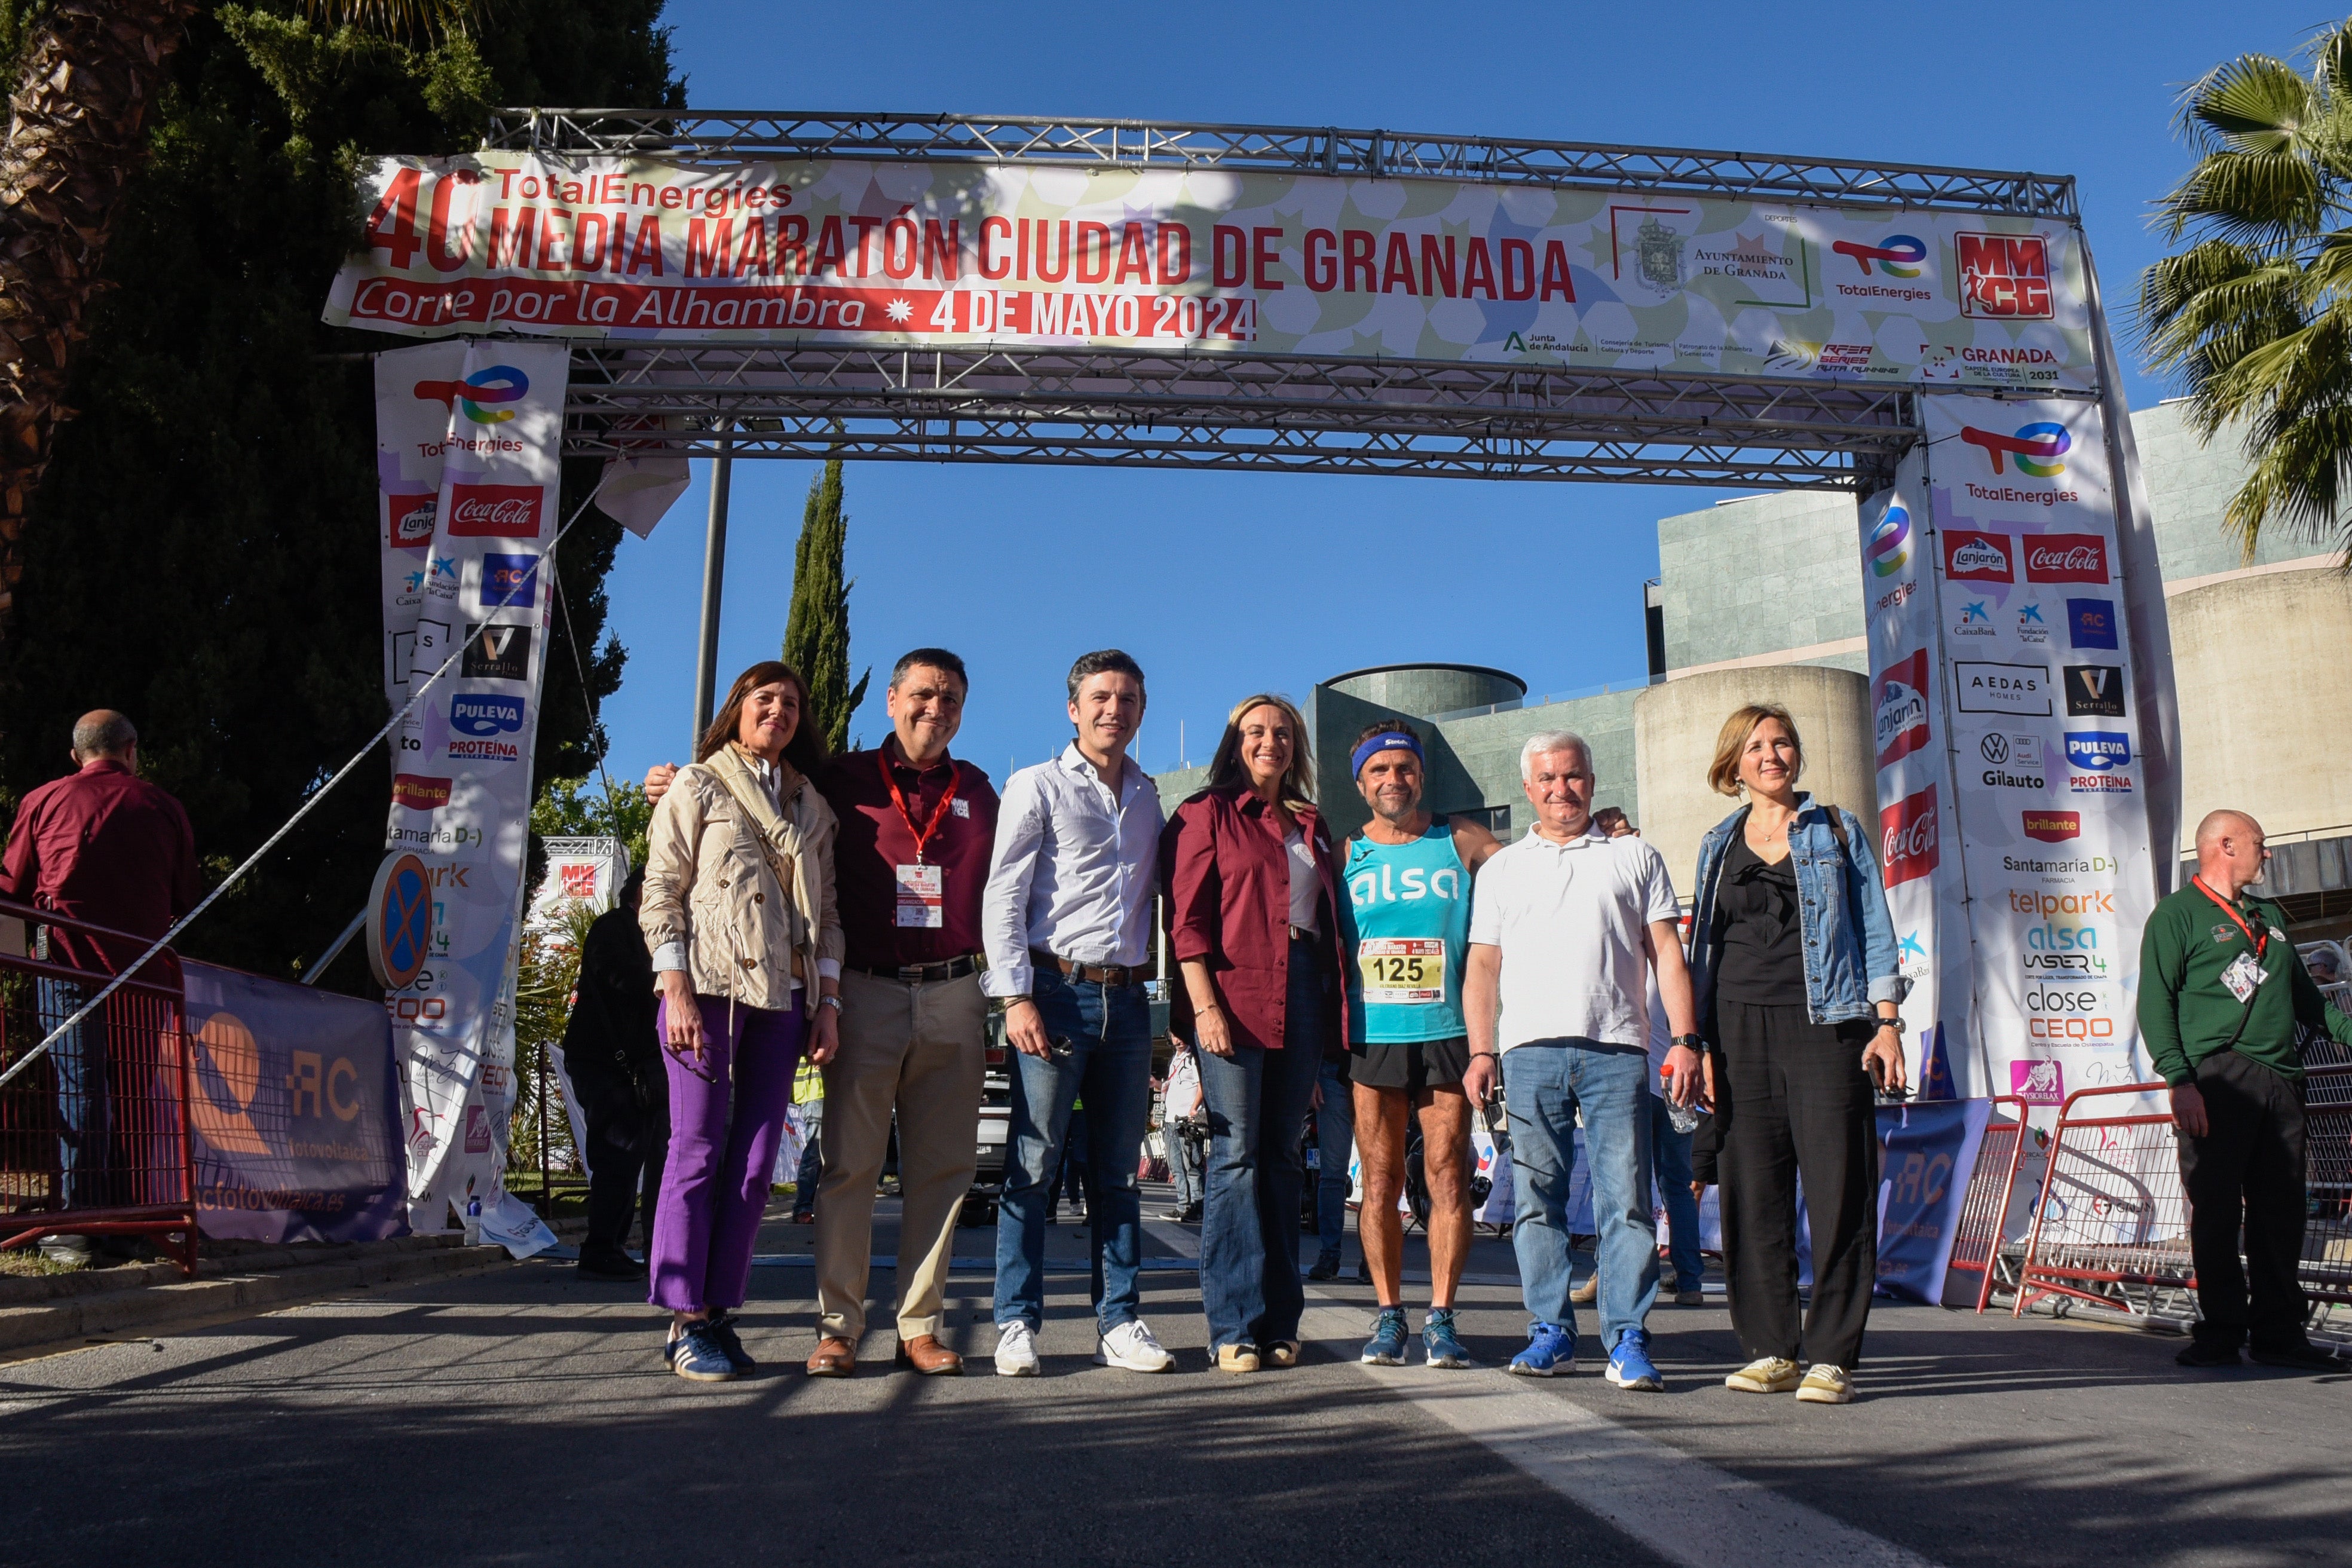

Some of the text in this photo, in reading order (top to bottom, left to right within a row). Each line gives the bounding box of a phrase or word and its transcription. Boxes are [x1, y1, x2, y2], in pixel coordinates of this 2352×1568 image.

[494, 169, 792, 219] TotalEnergies
[368, 167, 479, 271] 40
[1765, 214, 1797, 223] DEPORTES
[486, 205, 1576, 304] MEDIA MARATÓN CIUDAD DE GRANADA
[1694, 249, 1794, 267] AYUNTAMIENTO
[1836, 284, 1931, 301] TotalEnergies
[356, 281, 865, 327] Corre por la Alhambra
[930, 290, 1256, 342] 4 DE MAYO 2024
[1529, 333, 1555, 343] Junta
[1679, 342, 1708, 351] Patronato
[1529, 341, 1588, 353] de Andalucía
[1823, 344, 1873, 356] RFEA
[1962, 347, 2058, 364] GRANADA
[1817, 364, 1900, 374] RUTA RUNNING
[1820, 355, 1869, 366] SERIES
[2029, 370, 2060, 381] 2031
[1965, 483, 2078, 506] TotalEnergies
[454, 498, 537, 524] Coca-Cola
[1956, 550, 2003, 565] Lanjarón
[2029, 546, 2101, 571] Coca-Cola
[1954, 626, 1996, 636] CaixaBank
[2017, 626, 2048, 636] Fundación
[471, 661, 518, 672] Serrallo
[1973, 676, 2037, 691] AEDAS
[1989, 691, 2022, 701] HOMES
[455, 703, 518, 721] PULEVA
[2075, 701, 2117, 710] Serrallo
[2069, 740, 2126, 755] PULEVA
[1983, 770, 2044, 789] Gilauto
[393, 782, 447, 799] brillante
[2027, 818, 2077, 831] brillante
[399, 845, 435, 855] FARMACIA
[2003, 856, 2089, 872] Santamaría
[1350, 863, 1459, 906] alsa
[2009, 889, 2115, 920] telpark
[2028, 923, 2097, 950] alsa
[1373, 957, 1424, 982] 125
[2093, 954, 2106, 973] 4
[2026, 982, 2097, 1012] close
[2029, 1018, 2113, 1042] CEQO
[287, 1139, 369, 1162] fotovoltaica
